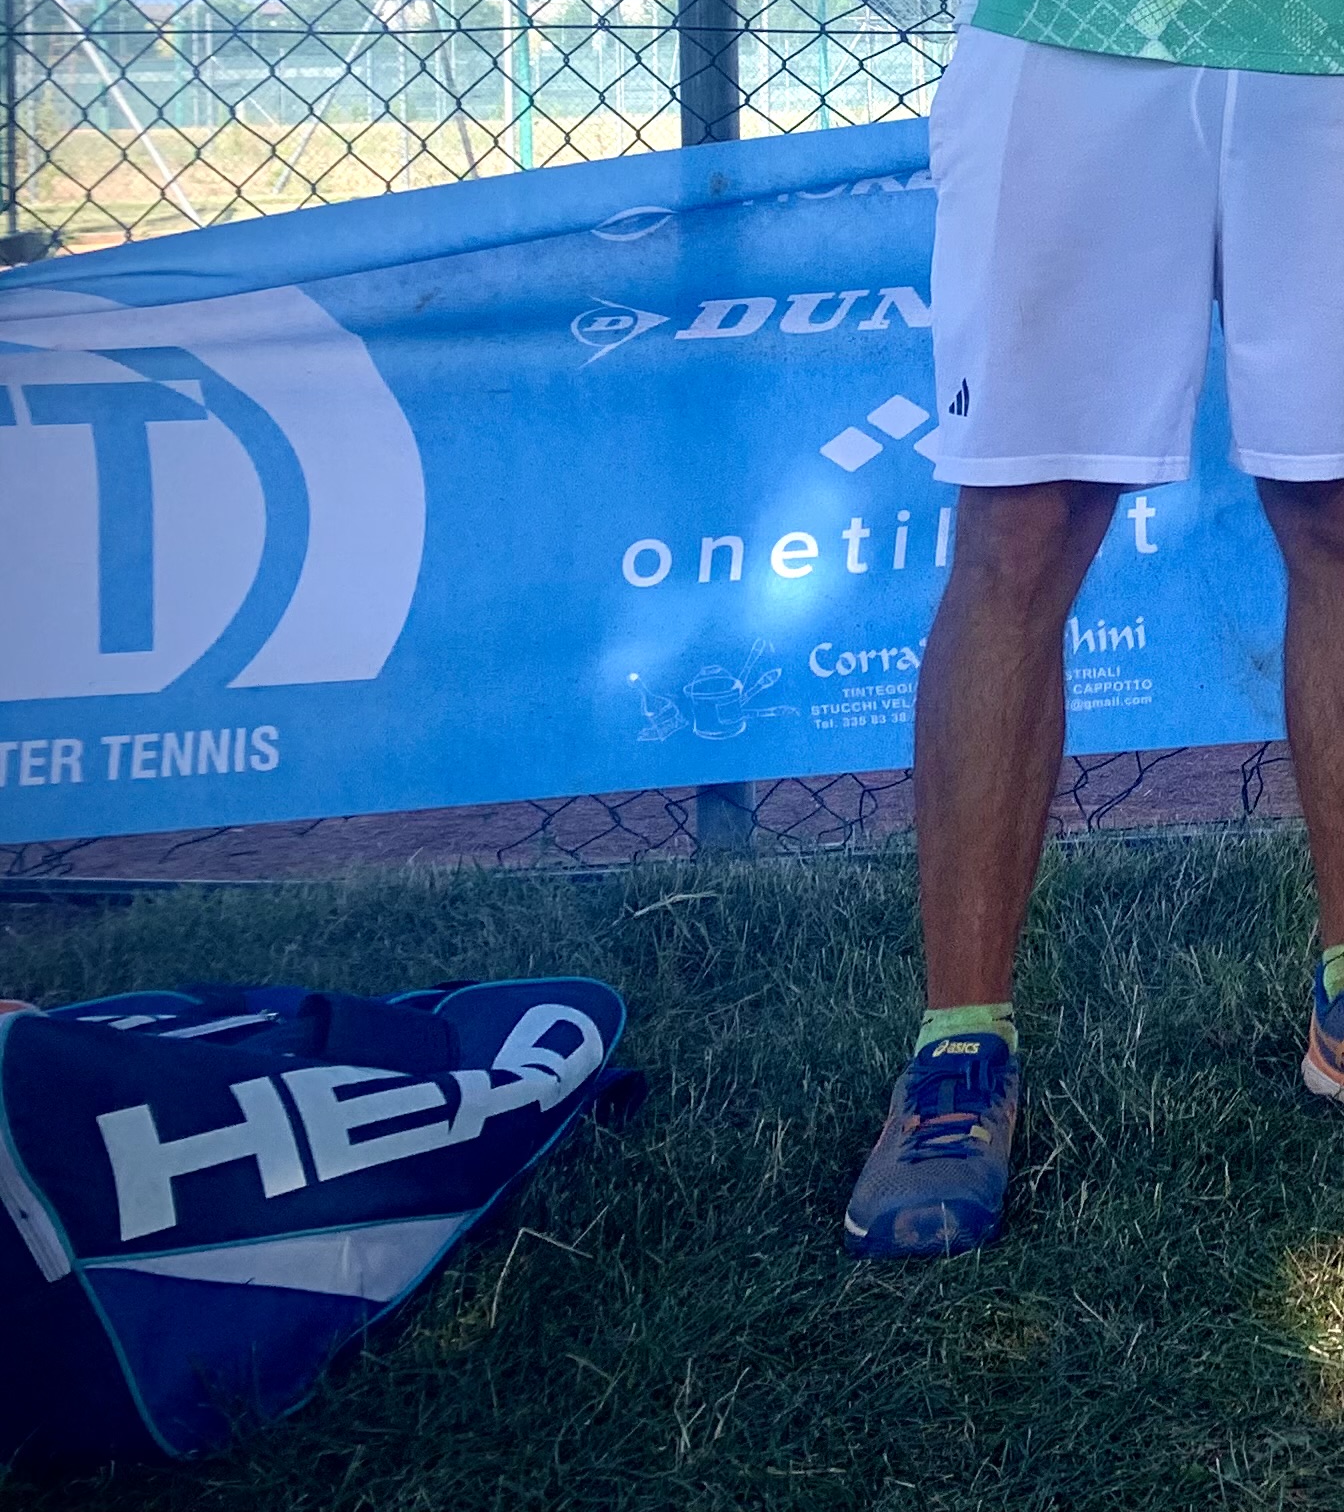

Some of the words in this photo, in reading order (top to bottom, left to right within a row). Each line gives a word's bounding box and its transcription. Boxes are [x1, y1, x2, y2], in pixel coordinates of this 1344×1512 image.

[809, 637, 926, 679] Corra
[811, 700, 878, 717] STUCCHI
[1073, 678, 1154, 696] CAPPOTTO
[101, 725, 280, 782] TENNIS
